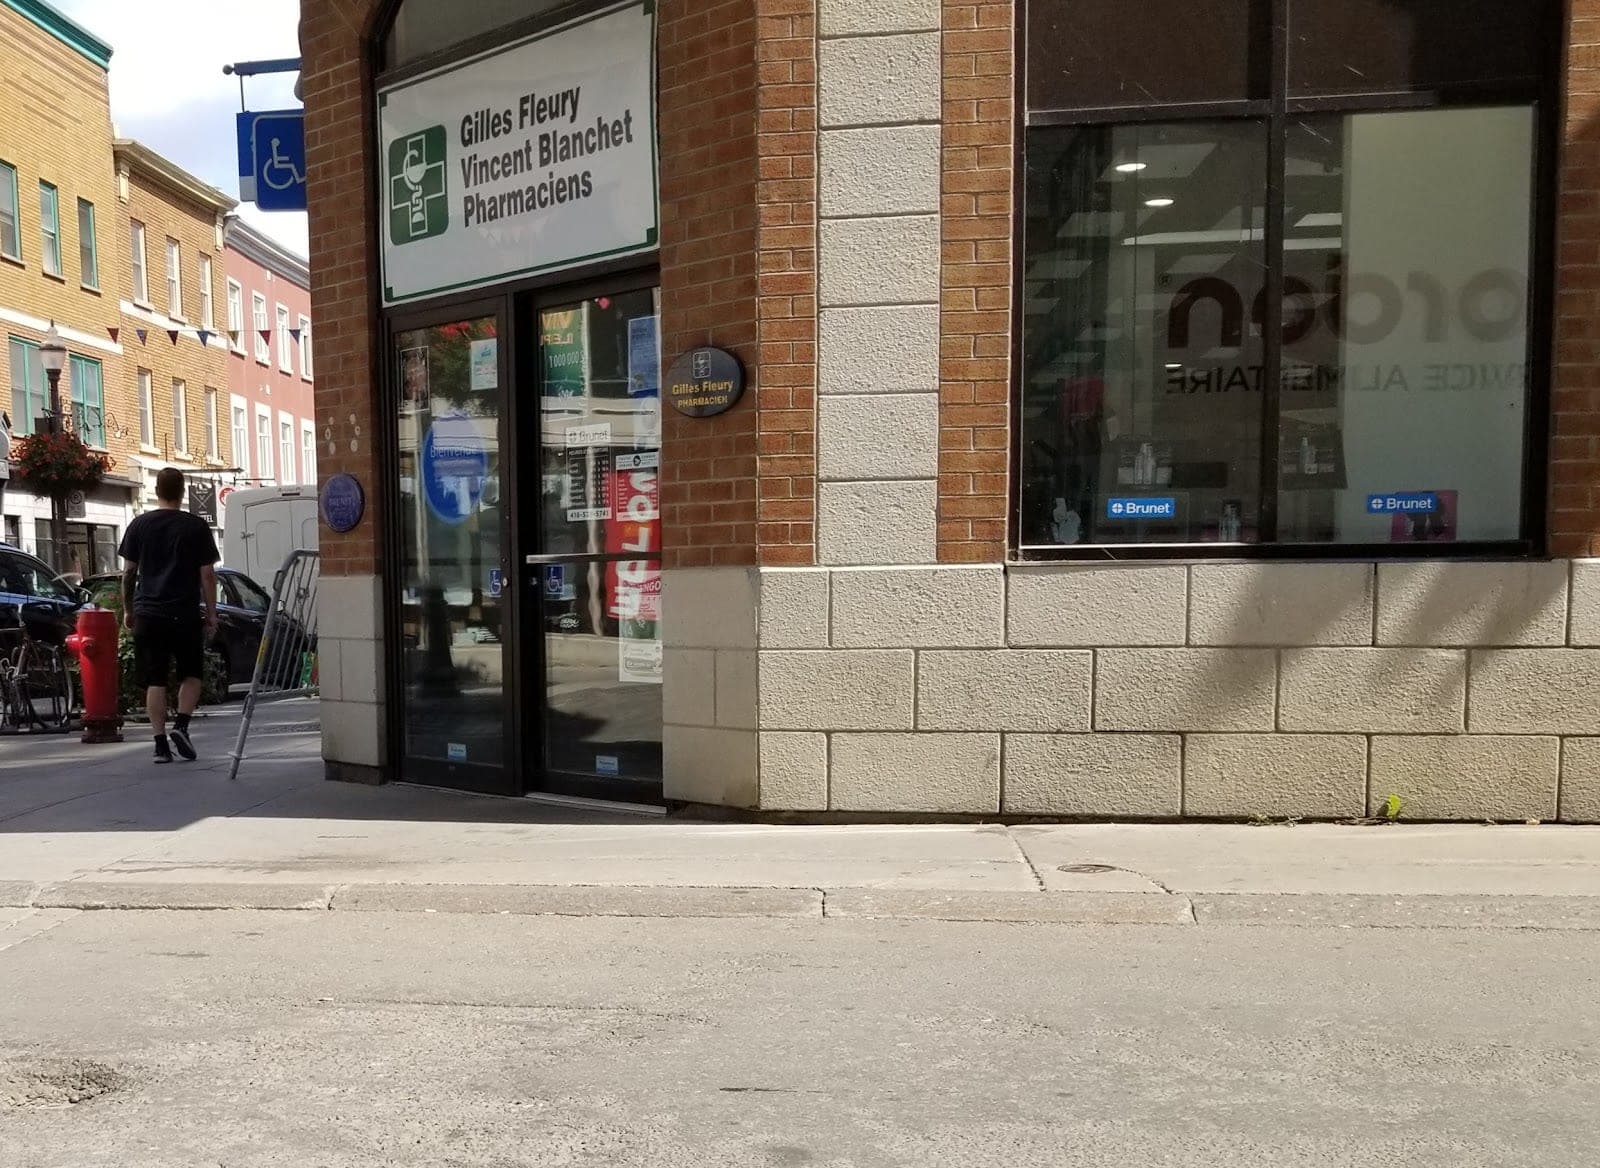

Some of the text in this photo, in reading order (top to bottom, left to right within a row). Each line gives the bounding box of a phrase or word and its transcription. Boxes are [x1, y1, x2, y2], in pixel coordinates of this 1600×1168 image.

[460, 86, 580, 147] Gilles Fleury
[461, 109, 633, 188] Vincent Blanchet
[463, 170, 593, 228] Pharmaciens
[672, 380, 734, 395] Gilles Fleury
[677, 395, 728, 408] PHARMACIEN
[1126, 503, 1170, 513] Brunet
[1386, 497, 1432, 509] Brunet
[570, 509, 609, 518] 418-5-5741
